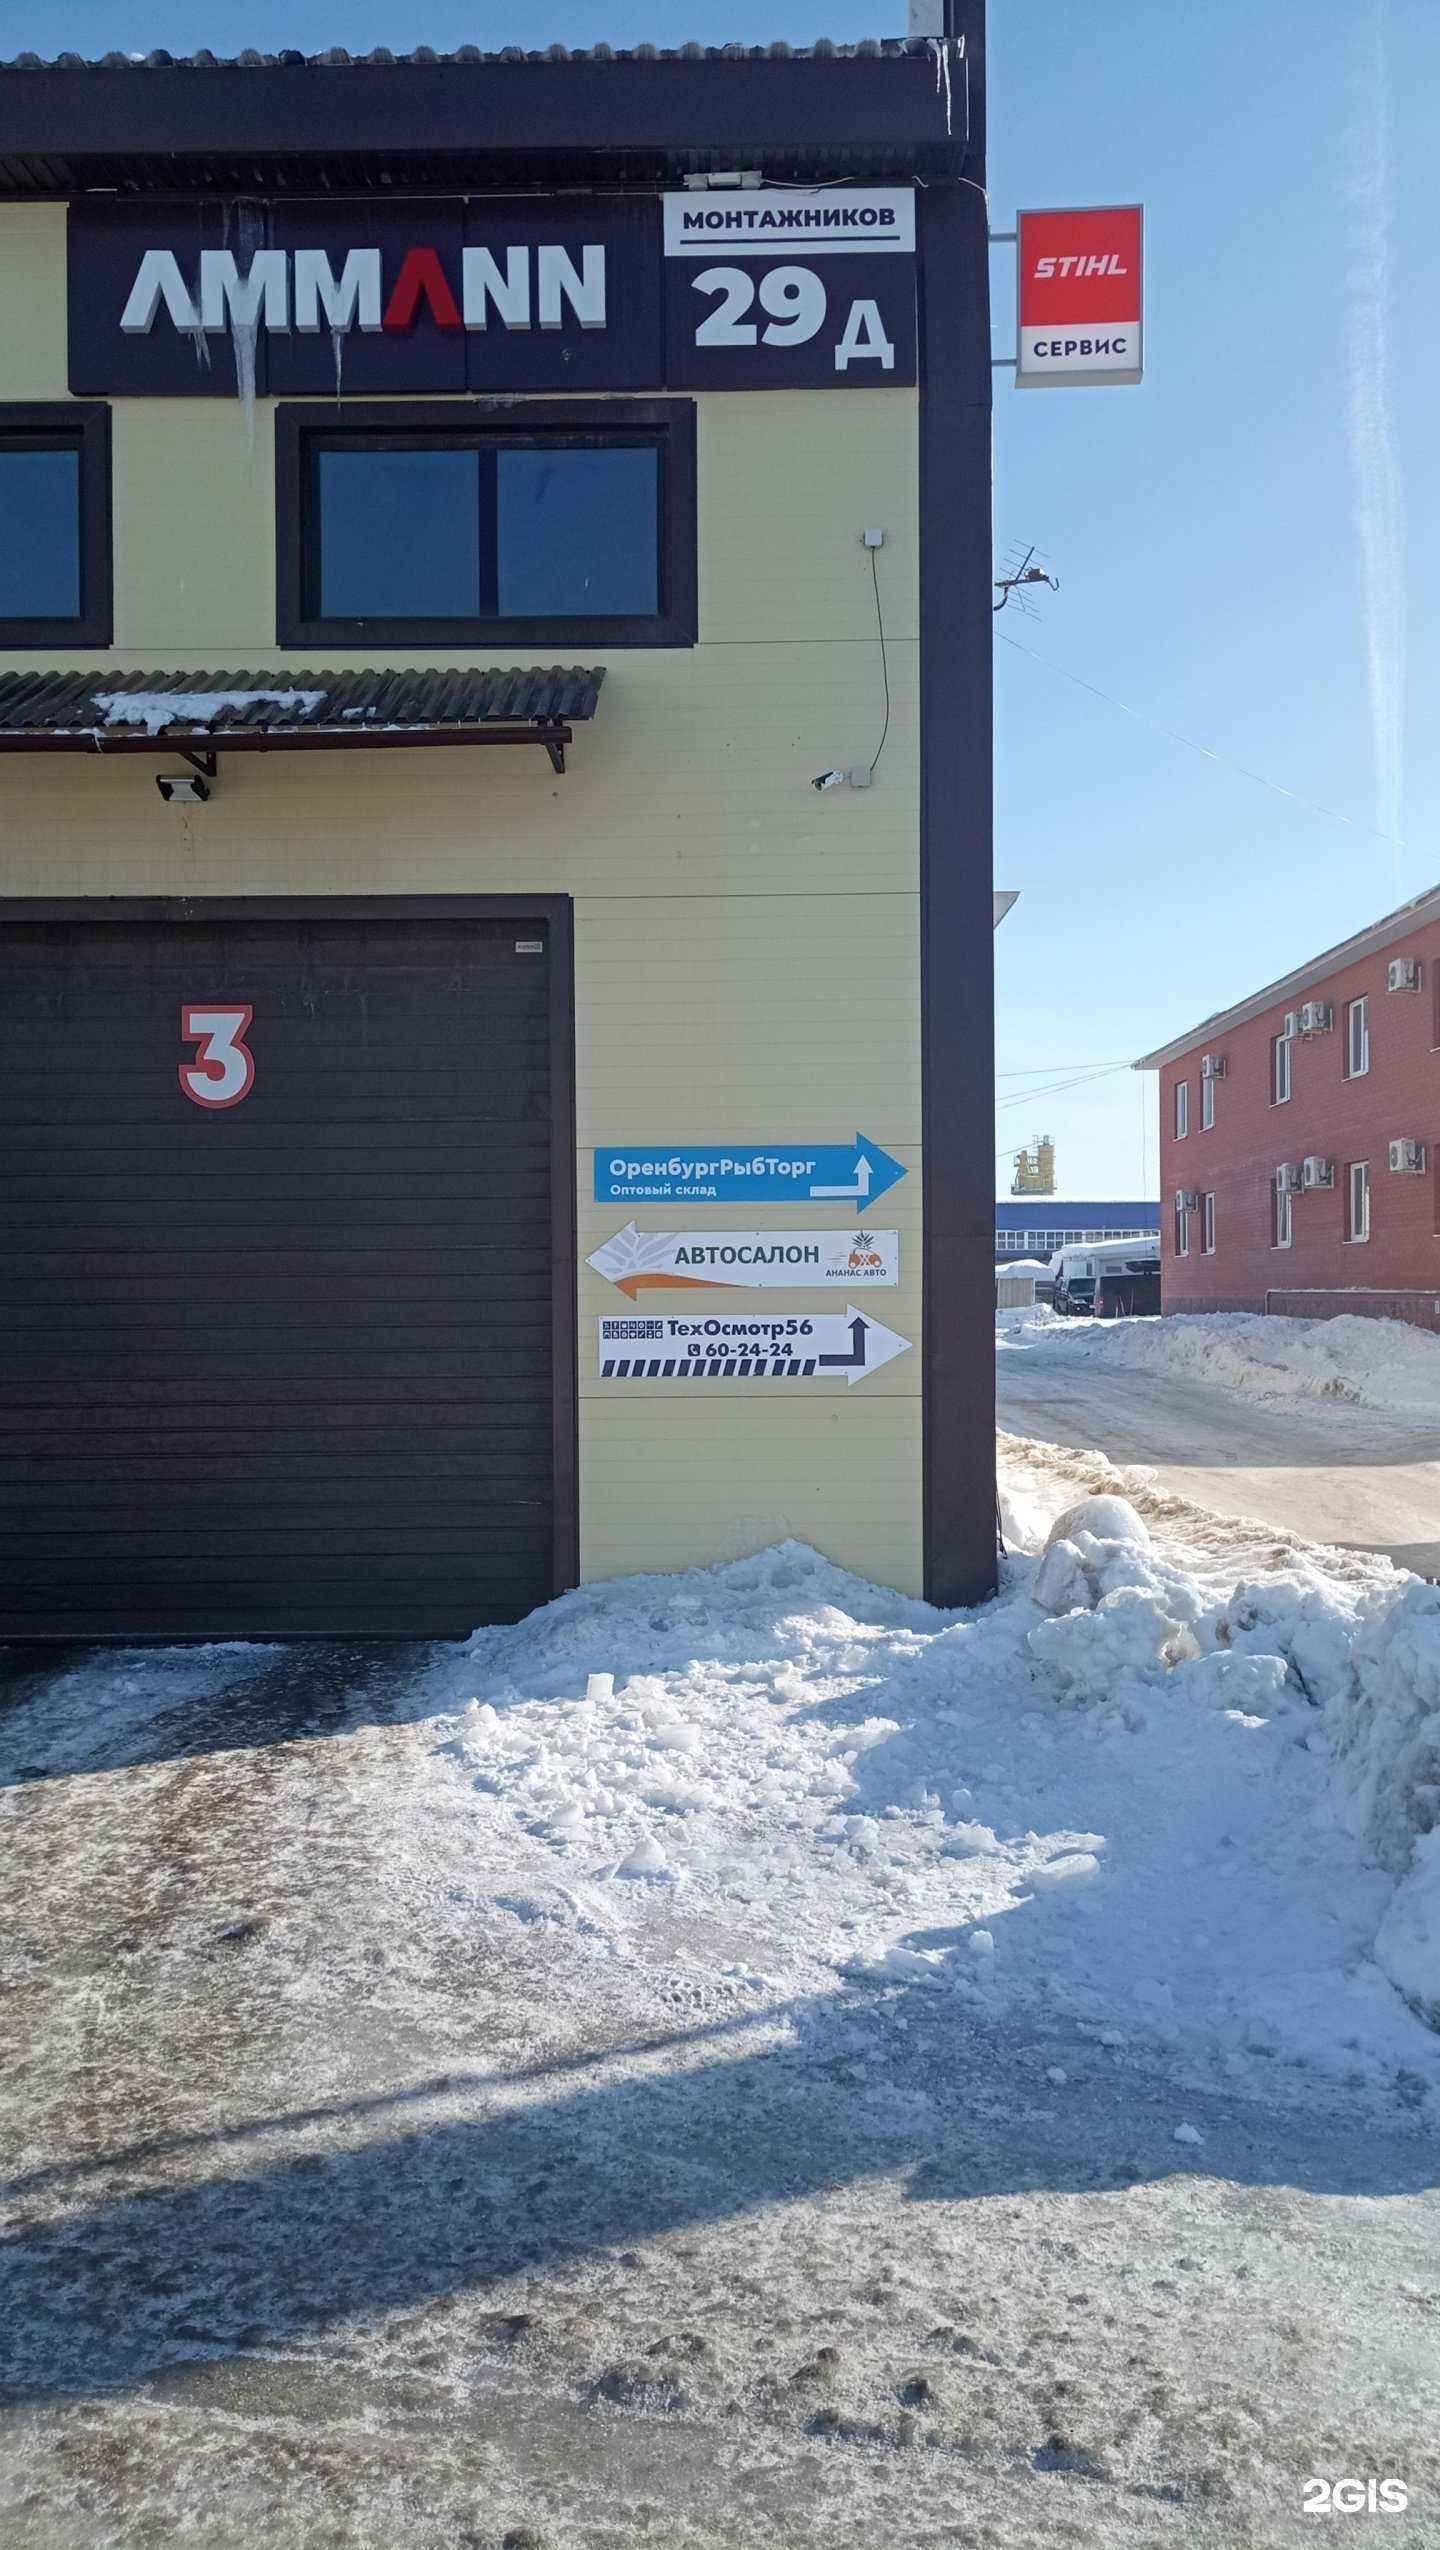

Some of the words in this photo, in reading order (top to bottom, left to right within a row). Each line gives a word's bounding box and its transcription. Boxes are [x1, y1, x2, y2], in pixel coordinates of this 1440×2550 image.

[682, 207, 896, 230] МОНТАЖНИКОВ
[1033, 253, 1129, 279] STIHL
[119, 245, 606, 334] AMMANN
[690, 265, 827, 346] 29
[1033, 337, 1128, 357] СЕРВИС
[178, 1004, 255, 1110] 3
[609, 1157, 817, 1179] ОренбургРыбТорг
[610, 1183, 672, 1196] Оптовый
[675, 1184, 717, 1197] склад
[674, 1245, 820, 1265] АВТОСАЛОН
[825, 1268, 861, 1277] АНАНАС
[863, 1268, 887, 1277] АВТО
[667, 1319, 813, 1341] ТехОсмотр56
[705, 1343, 794, 1357] 60-24-24
